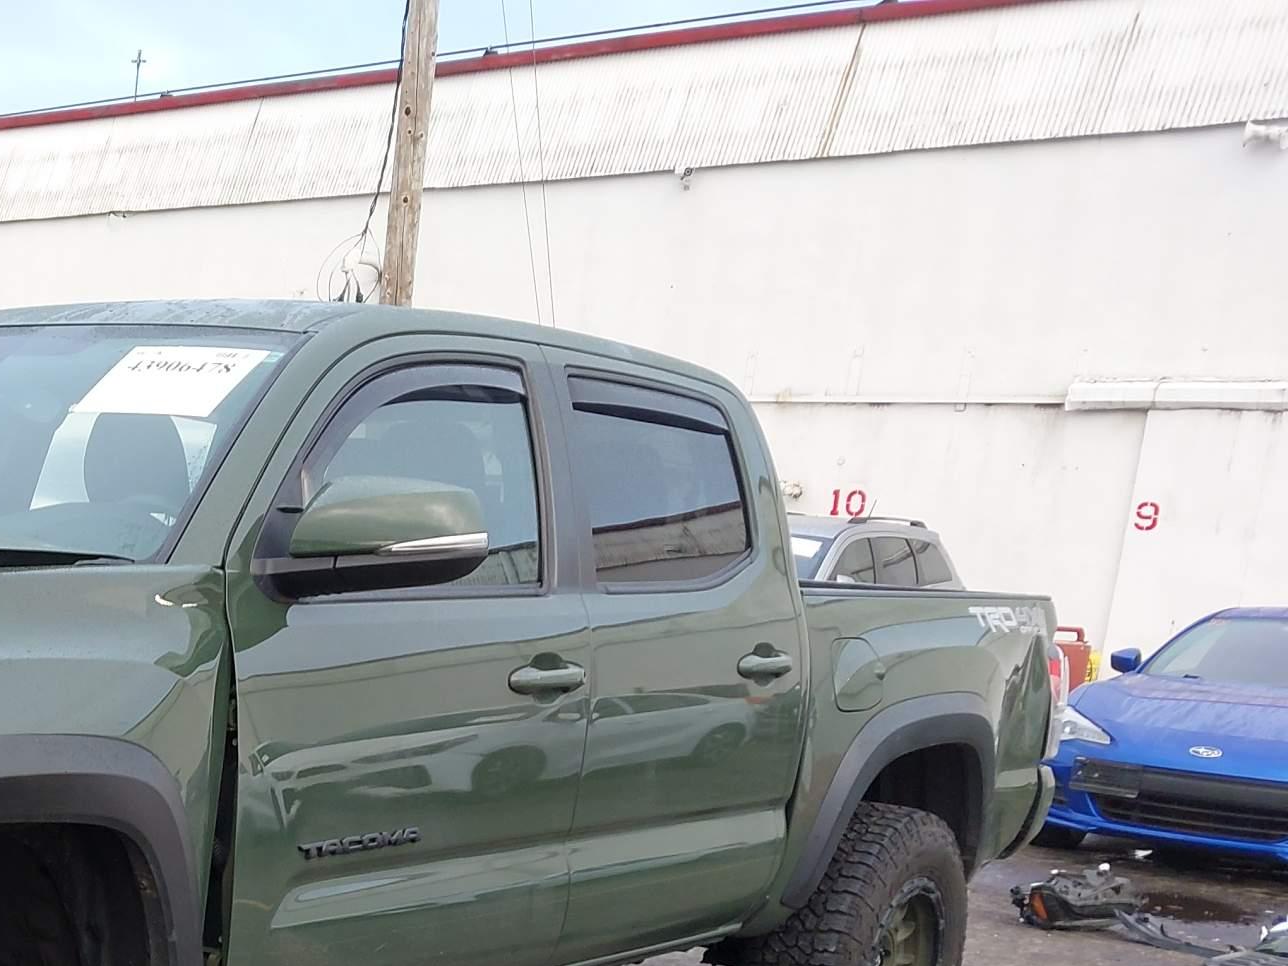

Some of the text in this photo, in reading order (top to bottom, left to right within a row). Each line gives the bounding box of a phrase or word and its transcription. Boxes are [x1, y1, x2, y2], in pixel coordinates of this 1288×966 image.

[830, 489, 866, 516] 10
[1134, 502, 1159, 530] 9
[968, 607, 1017, 633] TRD
[298, 826, 419, 859] TACOMA
